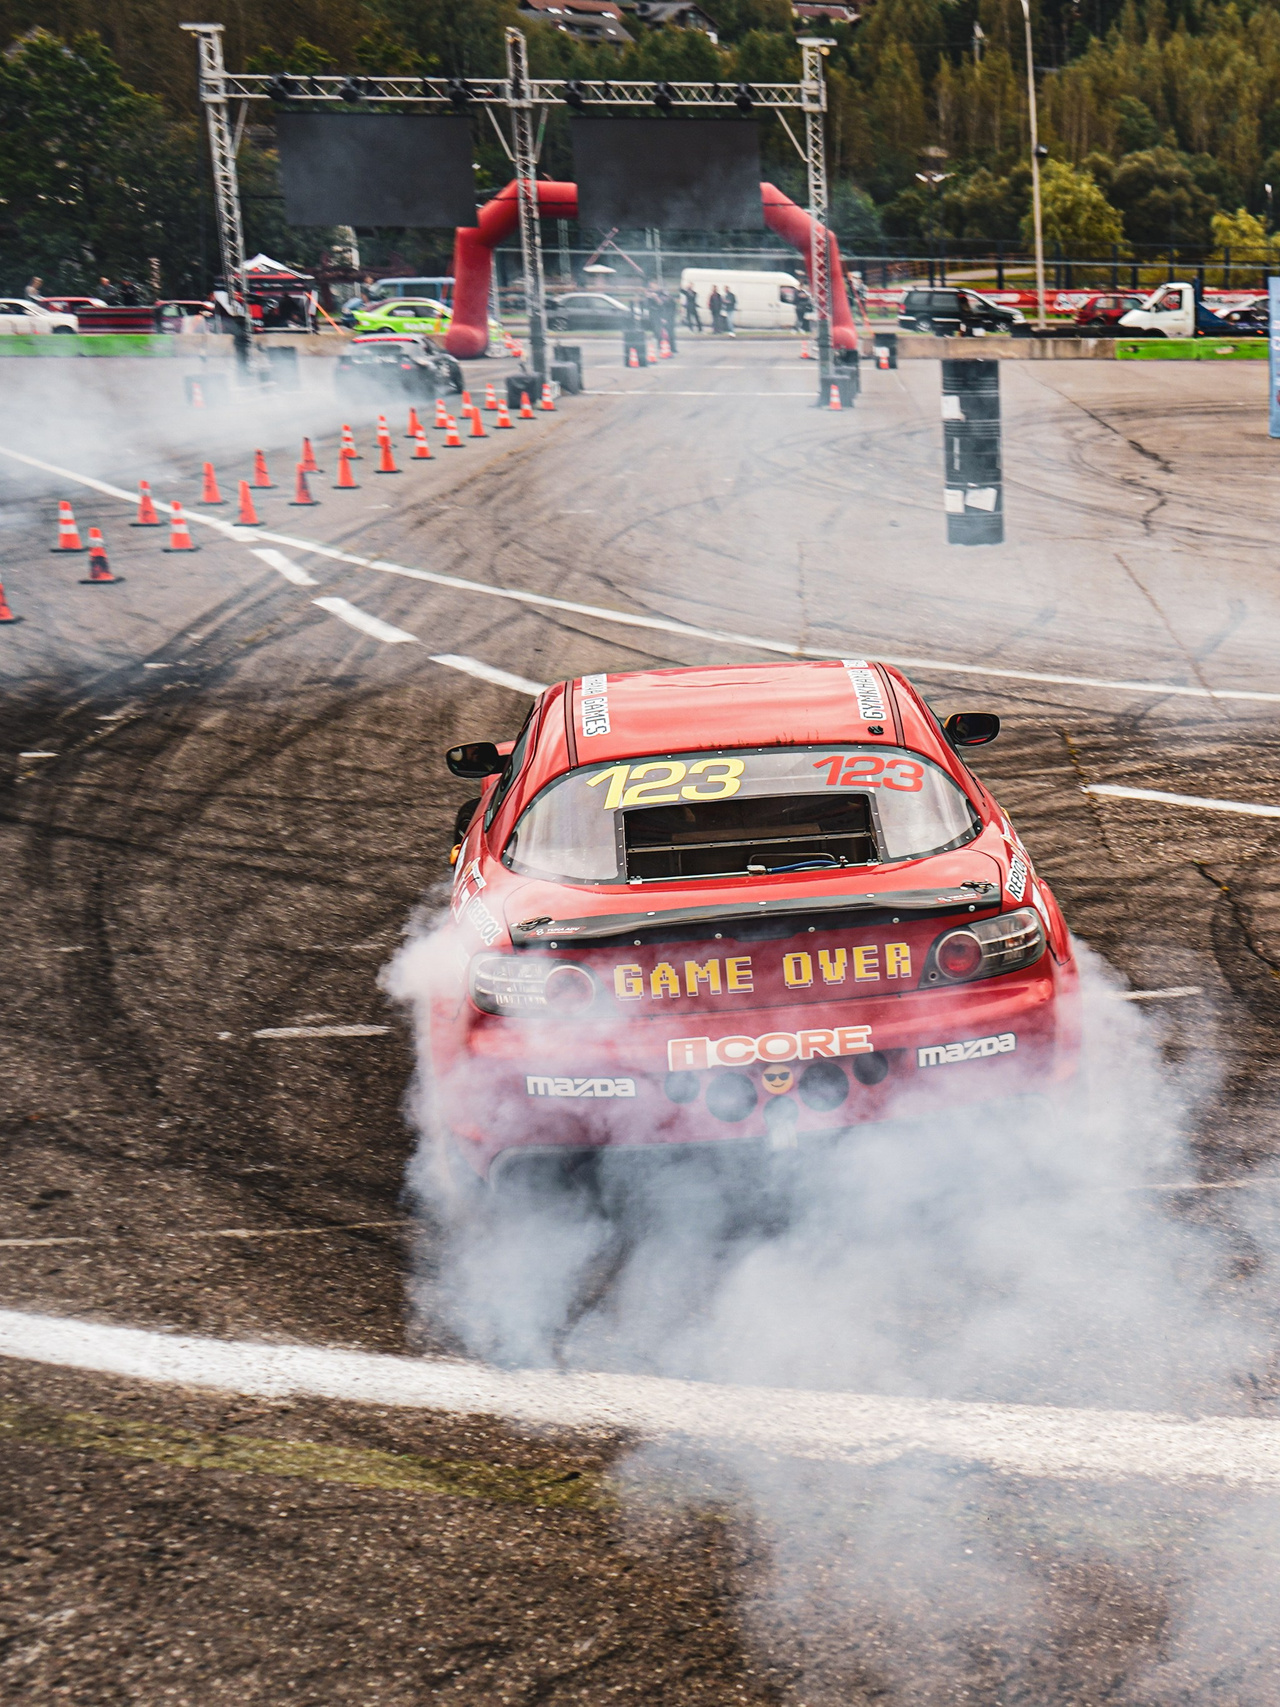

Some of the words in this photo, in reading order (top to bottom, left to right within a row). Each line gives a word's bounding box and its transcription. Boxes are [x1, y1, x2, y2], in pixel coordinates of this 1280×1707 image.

[584, 698, 608, 735] GAMES
[851, 670, 884, 719] GYMKHANA
[586, 758, 745, 810] 123
[812, 756, 924, 792] 123
[468, 899, 501, 944] REPSOL
[613, 956, 754, 1000] GAME
[783, 942, 912, 989] OVER
